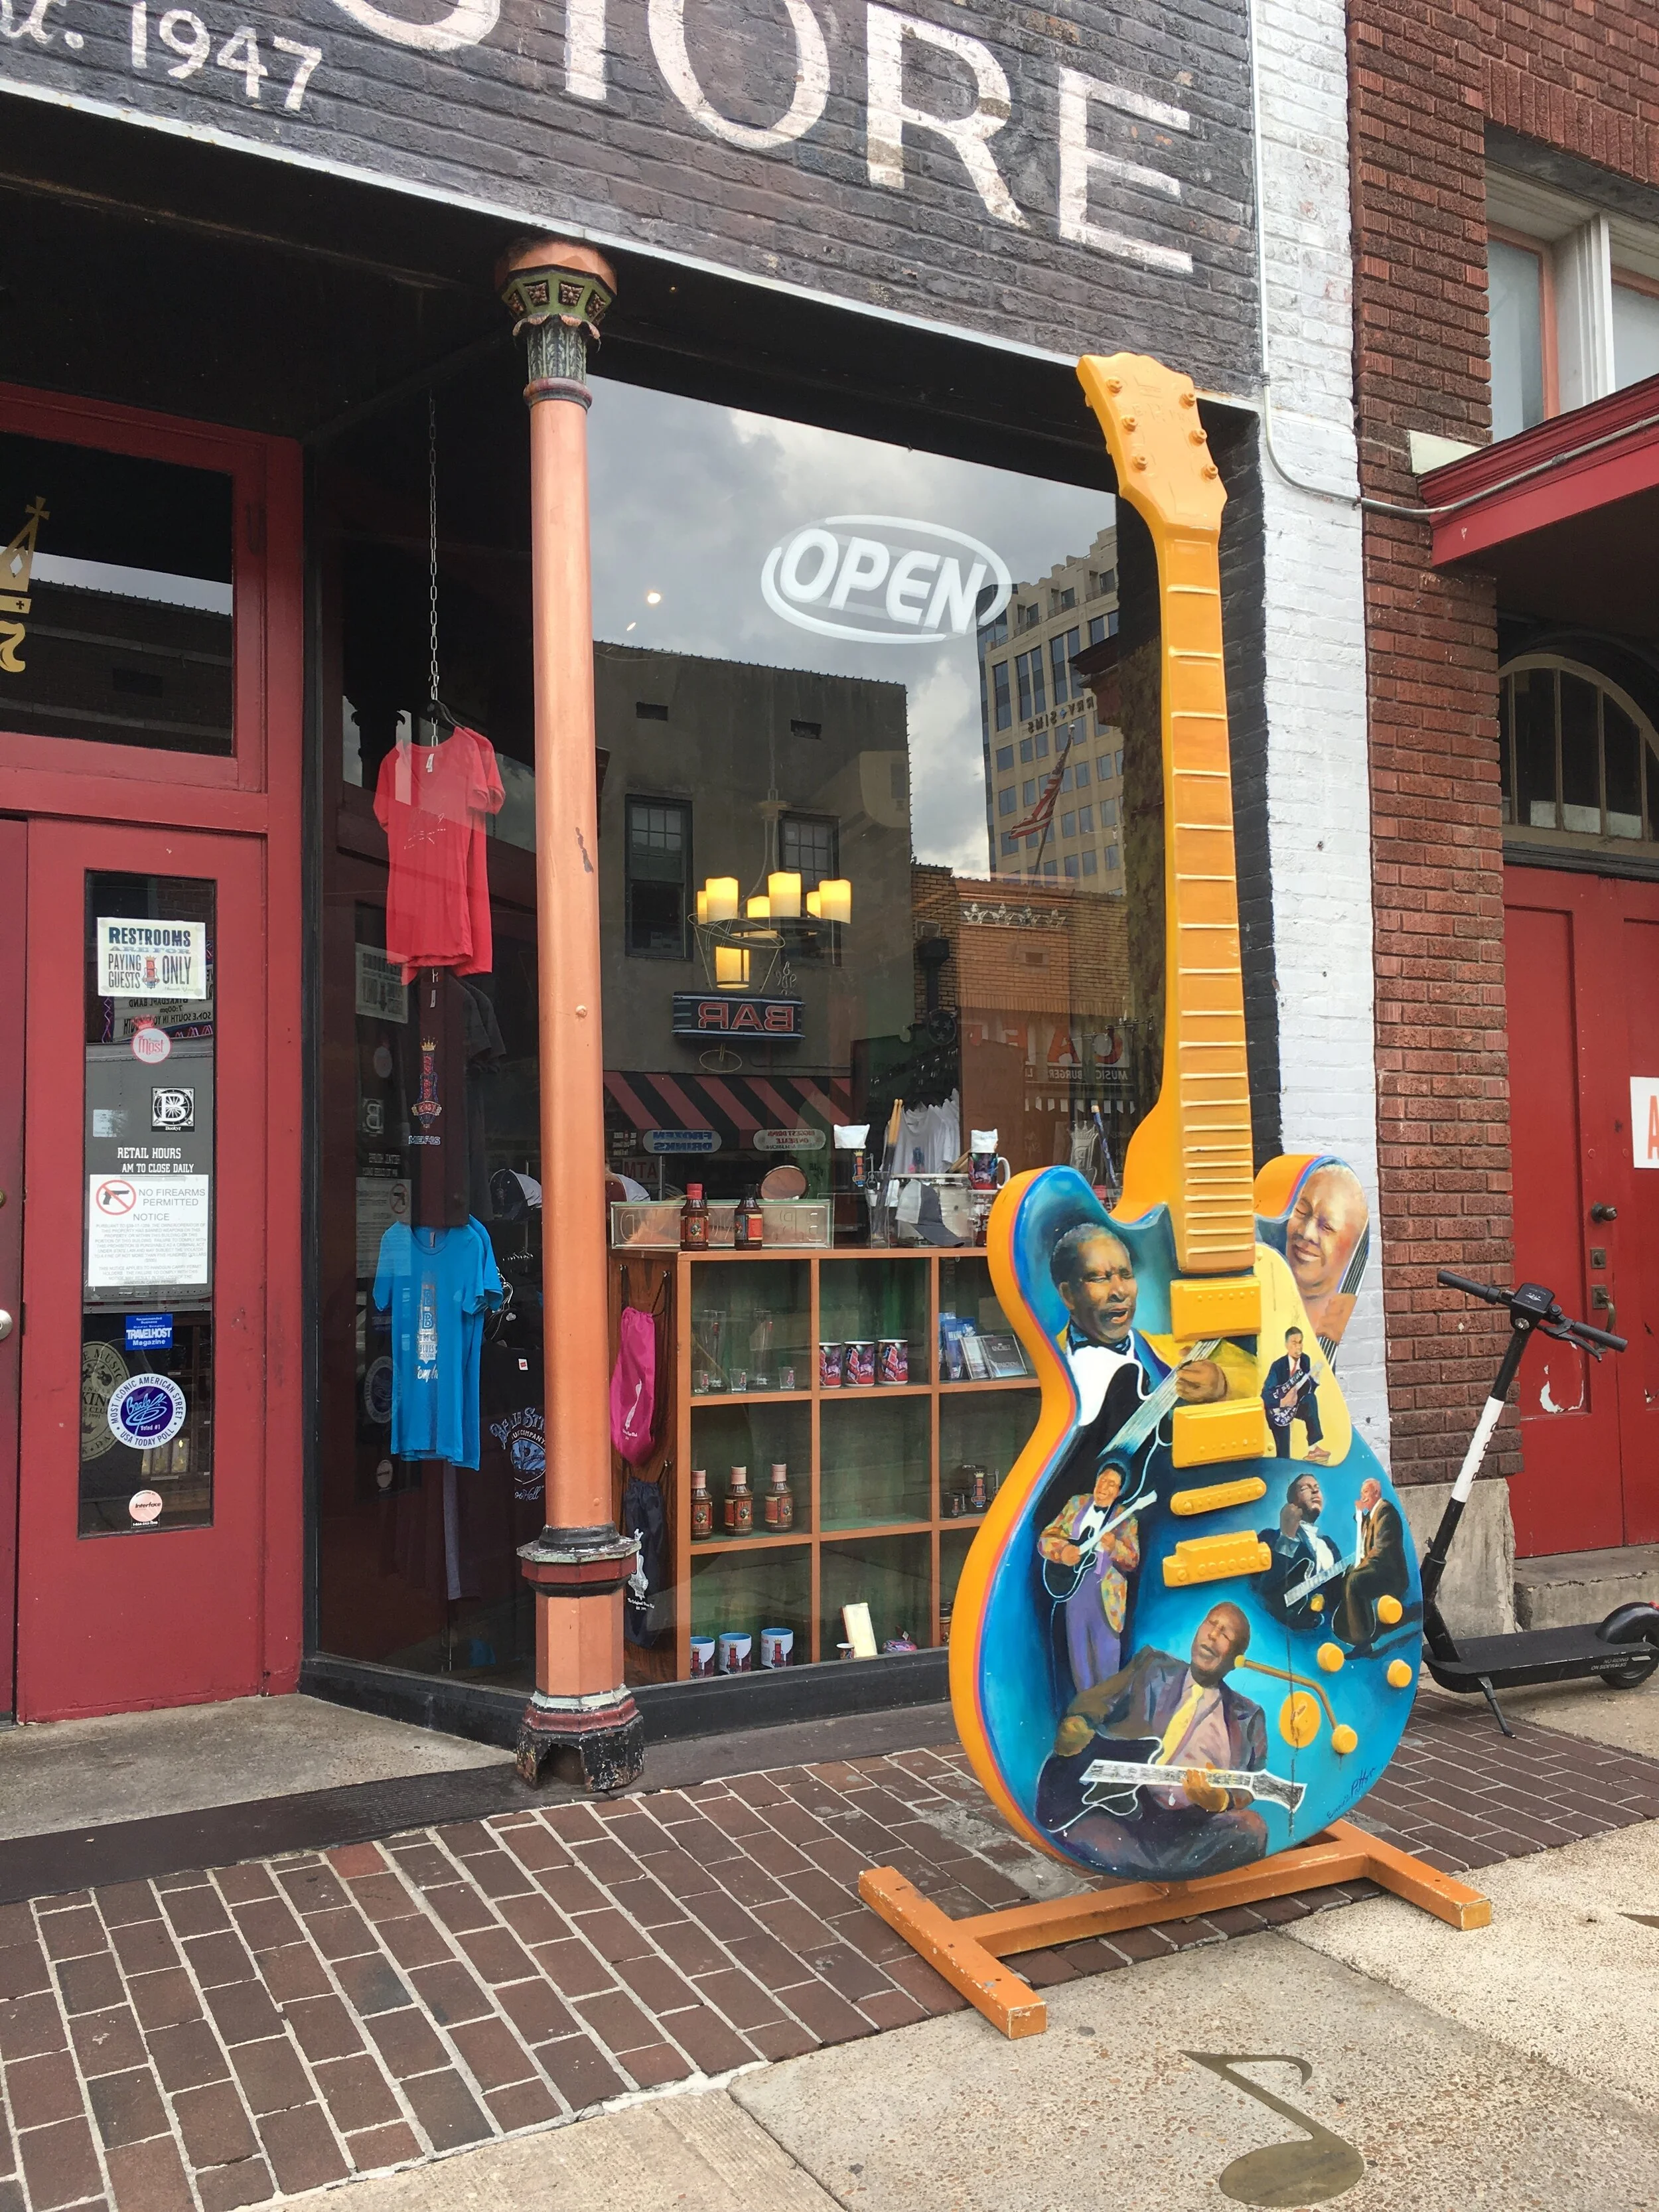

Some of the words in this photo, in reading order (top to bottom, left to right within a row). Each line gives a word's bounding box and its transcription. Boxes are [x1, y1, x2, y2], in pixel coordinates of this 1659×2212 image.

[132, 1, 323, 111] 1947
[780, 528, 987, 634] OPEN
[109, 926, 191, 947] RESTROOMS
[108, 954, 141, 971] PAYING
[163, 955, 191, 984] ONLY
[109, 971, 140, 988] GUESTS
[117, 1147, 149, 1159] RETAIL
[151, 1147, 181, 1159] HOURS
[122, 1163, 134, 1173] AM
[137, 1163, 146, 1173] TO
[148, 1163, 171, 1173] CLOSE
[173, 1163, 194, 1173] DAILY
[143, 1198, 198, 1207] PERMITTED
[125, 1327, 173, 1339] TRAVELHOST
[94, 1349, 124, 1380] MUSIC
[115, 1380, 137, 1401] ICONIC
[139, 1376, 175, 1393] AMERICAN
[173, 1392, 183, 1420] STREET
[126, 1393, 151, 1416] Beale
[120, 1431, 133, 1442] USA
[158, 1429, 175, 1442] POLL
